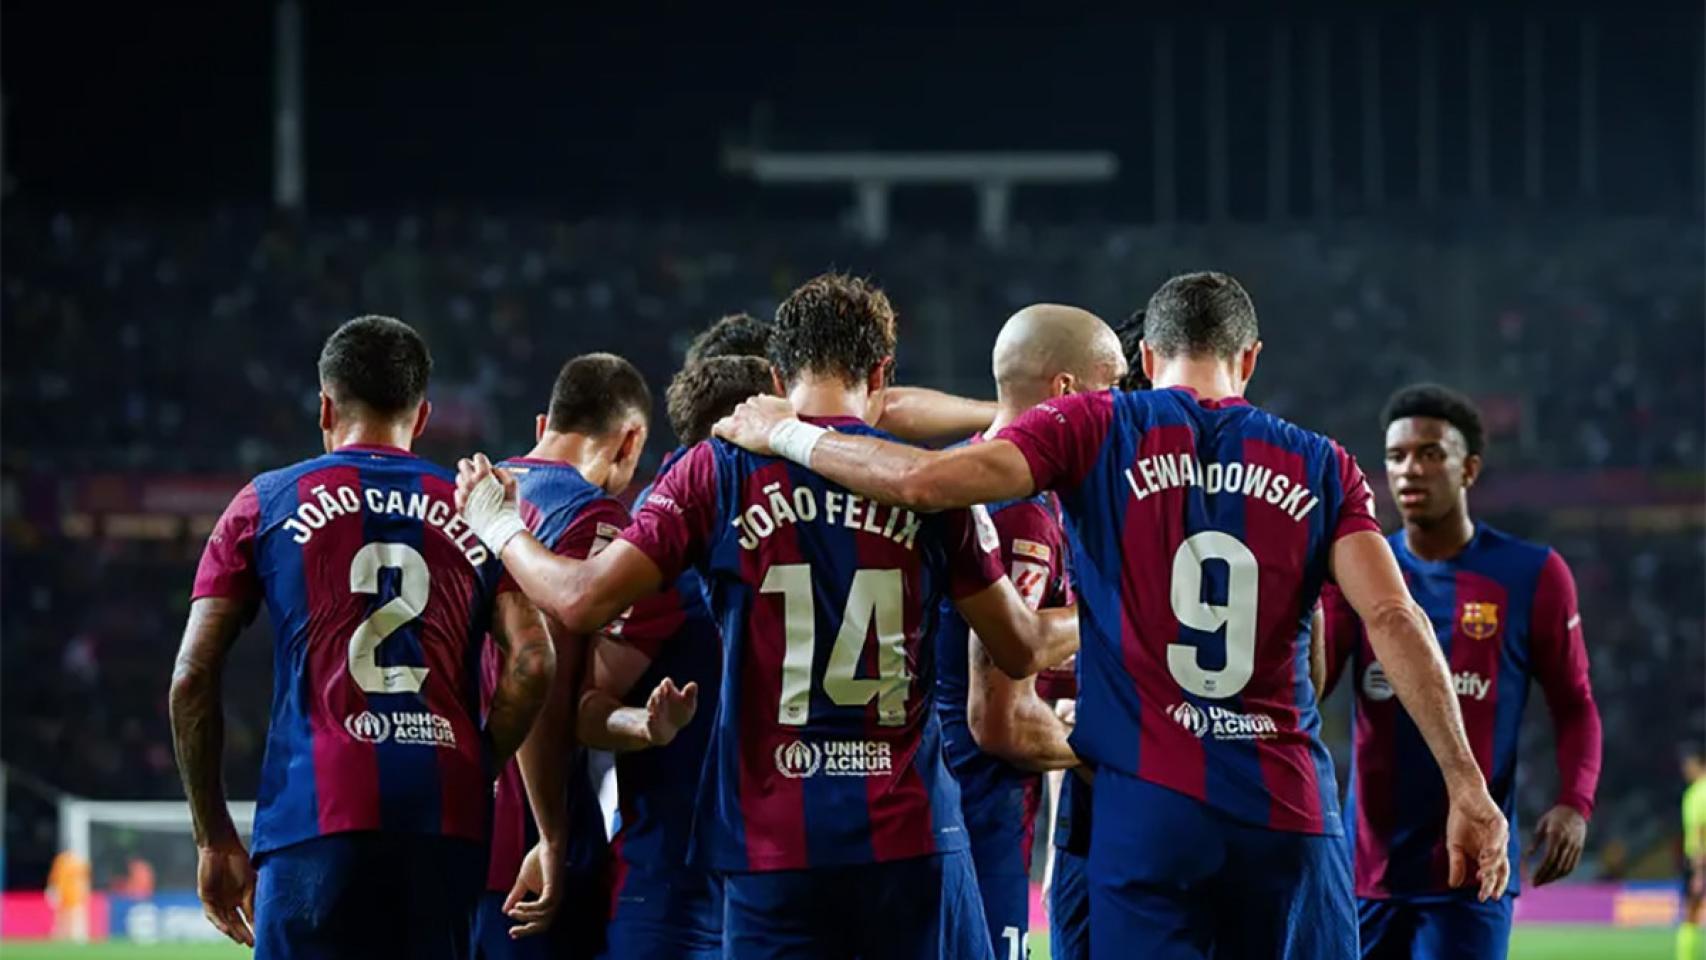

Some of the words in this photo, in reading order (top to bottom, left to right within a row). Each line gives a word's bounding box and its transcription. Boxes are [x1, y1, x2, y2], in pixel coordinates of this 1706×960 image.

[283, 484, 361, 544] JOÃO
[364, 488, 488, 567] CANCELO
[731, 481, 818, 550] JOÃO
[824, 490, 922, 550] FELIX
[347, 541, 431, 694] 2
[1166, 530, 1260, 699] 9
[759, 563, 911, 726] 14
[1452, 671, 1491, 700] tify
[391, 712, 452, 730] UNHCR
[394, 726, 456, 743] ACNUR
[1212, 719, 1278, 734] ACNUR
[824, 741, 891, 756] UNHCR
[825, 756, 892, 770] ACNUR
